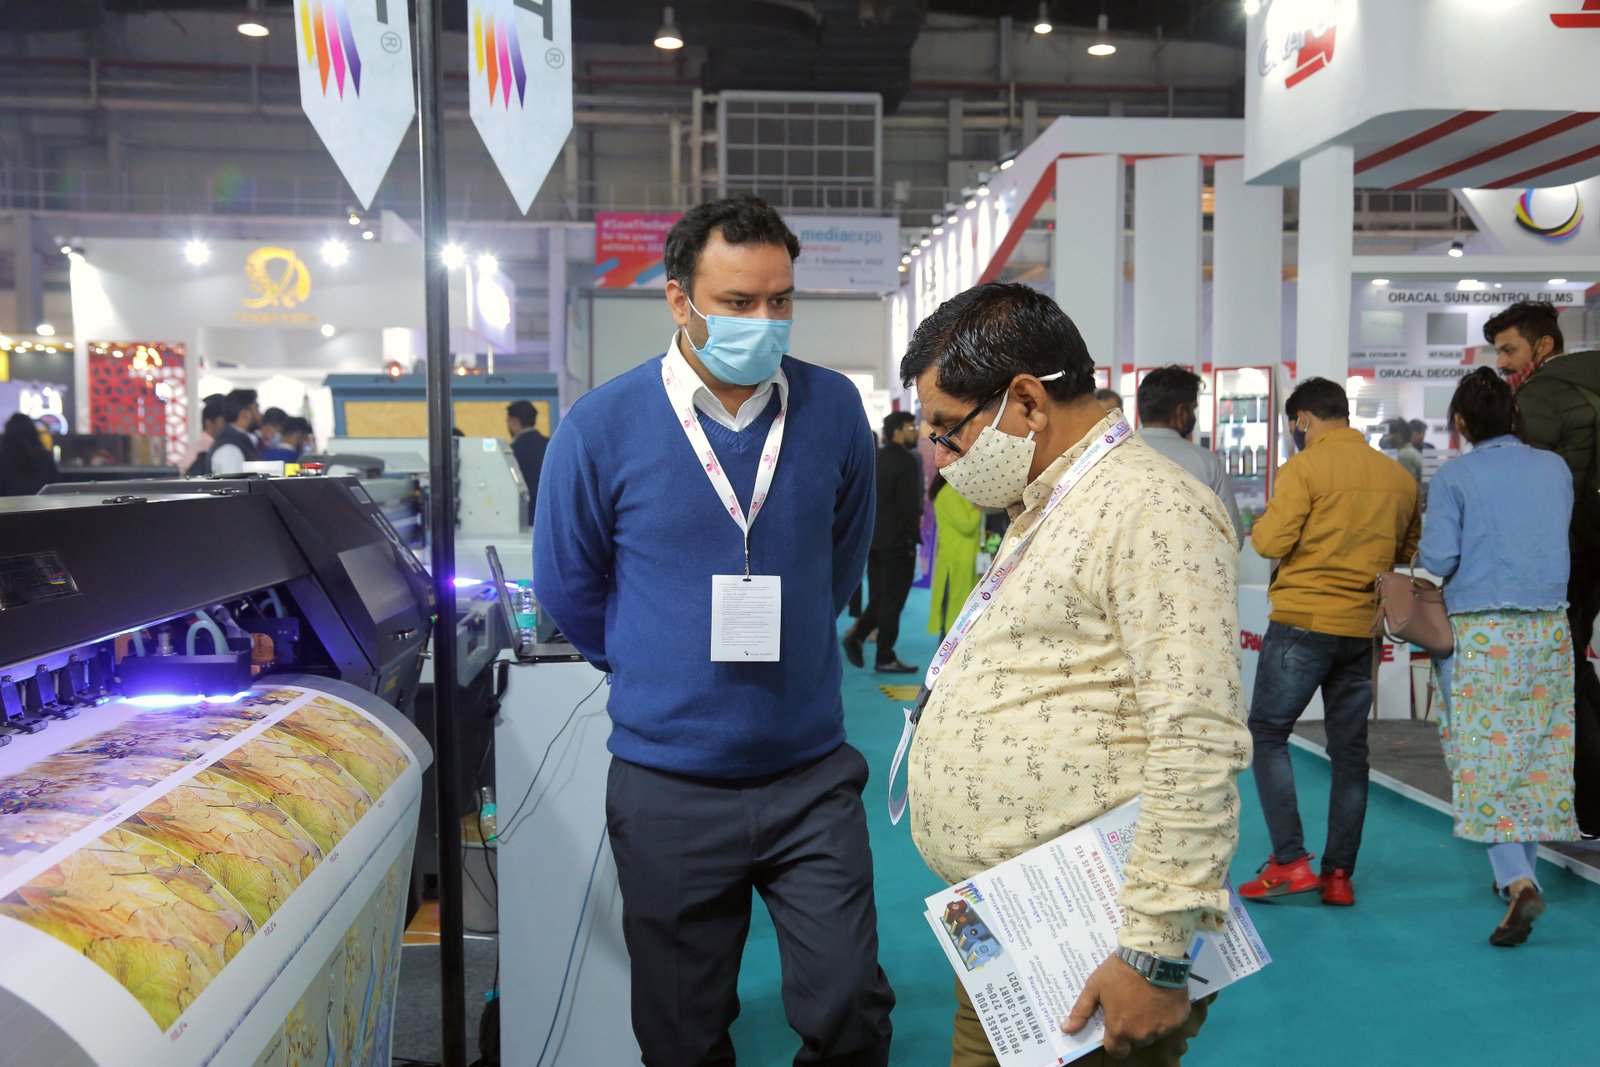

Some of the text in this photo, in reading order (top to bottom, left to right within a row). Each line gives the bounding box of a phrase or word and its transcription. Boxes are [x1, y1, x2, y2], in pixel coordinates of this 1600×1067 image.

[801, 226, 882, 245] mediaexpo
[1388, 291, 1574, 303] ORACAL SUN CONTROL FILMS
[1379, 369, 1424, 378] ORACAL
[1072, 444, 1101, 474] mediaexpo
[990, 566, 1004, 584] CDI
[954, 600, 979, 631] mediaexpo
[936, 640, 952, 657] CDI
[1095, 826, 1113, 855] Catalogue
[1051, 851, 1061, 865] want
[1074, 844, 1085, 858] YES
[1108, 854, 1117, 865] Get
[1057, 864, 1066, 876] and
[1072, 863, 1083, 880] trends
[1081, 858, 1089, 867] IS
[996, 876, 1004, 888] with
[1027, 863, 1042, 890] automatic
[1036, 867, 1050, 889] machine
[1054, 843, 1098, 923] expand your business with latest
[1063, 875, 1076, 897] business
[1085, 867, 1106, 900] QUESTION
[1102, 873, 1117, 896] CODES
[990, 877, 1005, 903] customers
[1040, 890, 1048, 902] with
[1046, 888, 1061, 910] printing
[1053, 875, 1075, 912] Expansion
[1079, 879, 1094, 902] printing
[1001, 902, 1014, 919] profit
[1011, 892, 1025, 914] quantity
[1026, 896, 1041, 922] Labour
[1041, 908, 1049, 916] get
[1073, 896, 1088, 919] printing
[1102, 901, 1117, 924] ABOVE
[1008, 917, 1018, 930] high
[1021, 914, 1032, 929] small
[1056, 909, 1069, 928] digital
[1018, 923, 1027, 935] need
[1048, 923, 1058, 938] Want
[1024, 935, 1032, 946] who
[1088, 930, 1105, 959] and unable
[1099, 937, 1108, 948] due
[1222, 931, 1244, 968] ANY FABRIC
[1225, 919, 1251, 965] DARK T-SHIRTS
[1057, 942, 1071, 964] printing
[1066, 946, 1077, 962] want
[1036, 958, 1051, 984] garments
[1074, 962, 1082, 972] who
[1225, 954, 1236, 972] HIGH
[1048, 985, 1056, 993] for
[1052, 976, 1061, 989] price
[1060, 969, 1078, 998] T-shirts
[1041, 988, 1054, 1007] digital
[1051, 993, 1064, 1014] solution
[1057, 990, 1065, 1000] low
[998, 984, 1030, 1040] WITH T-SHIRT
[1006, 971, 1045, 1044] PRINTING IN 2021
[1050, 1007, 1058, 1015] for
[1063, 1000, 1072, 1011] very
[974, 991, 1009, 1055] INCREASE YOUR
[984, 982, 1022, 1054] PROFIT BY 270%
[1041, 1006, 1057, 1032] Digital
